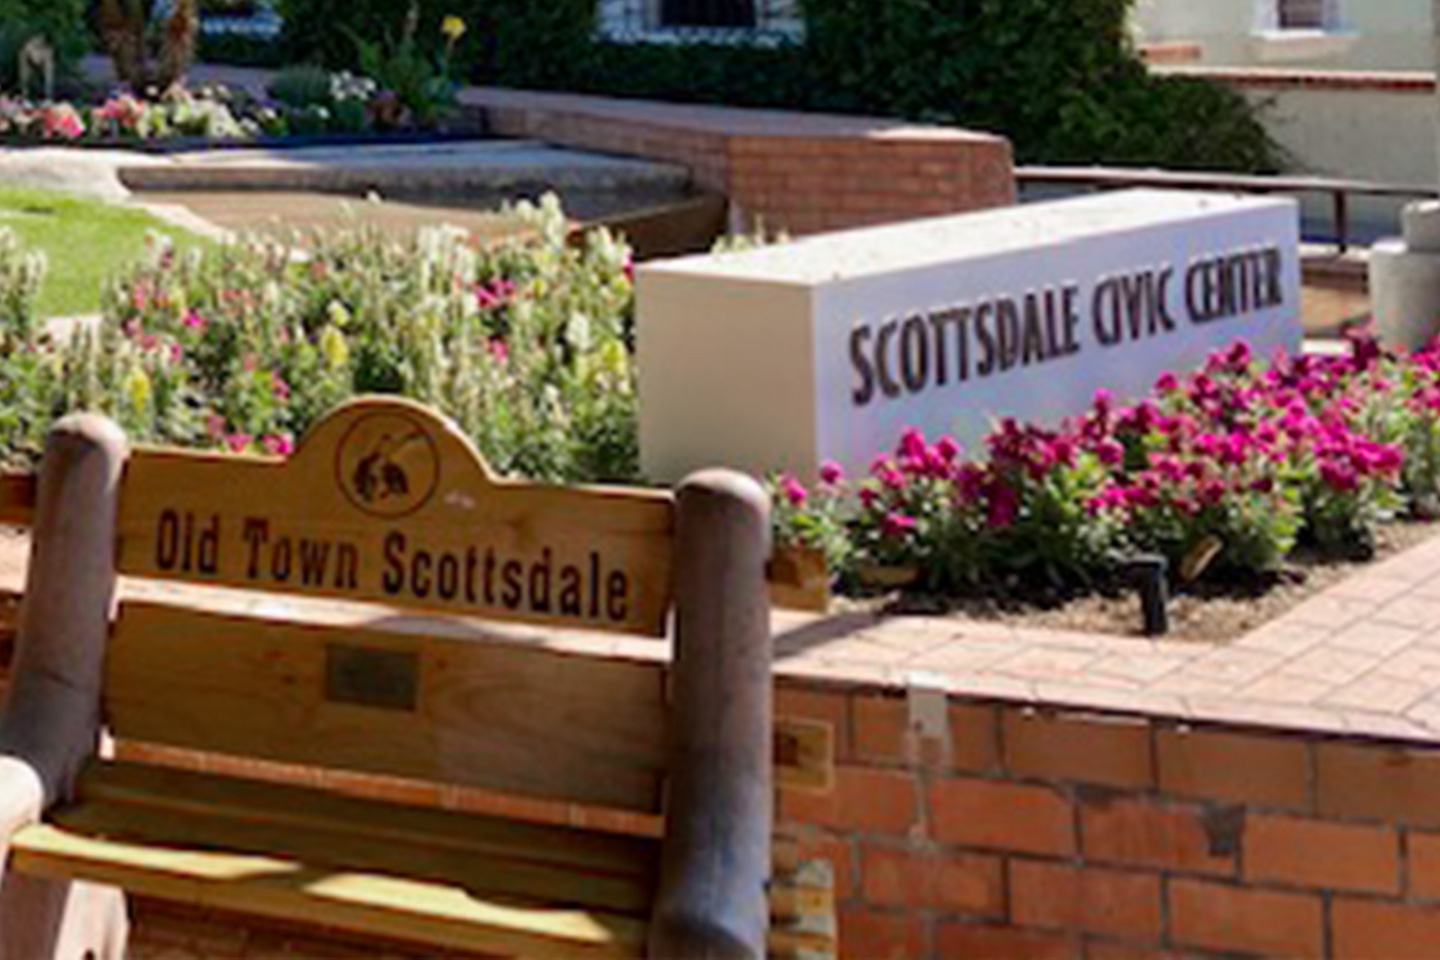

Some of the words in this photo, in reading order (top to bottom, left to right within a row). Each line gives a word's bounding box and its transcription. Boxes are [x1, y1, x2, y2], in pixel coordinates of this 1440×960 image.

[848, 285, 1081, 406] SCOTTSDALE
[1091, 267, 1175, 346] CIVIC
[1184, 247, 1283, 324] CENTER
[155, 509, 221, 575] Old
[242, 517, 359, 590] Town
[382, 531, 629, 622] Scottsdale
